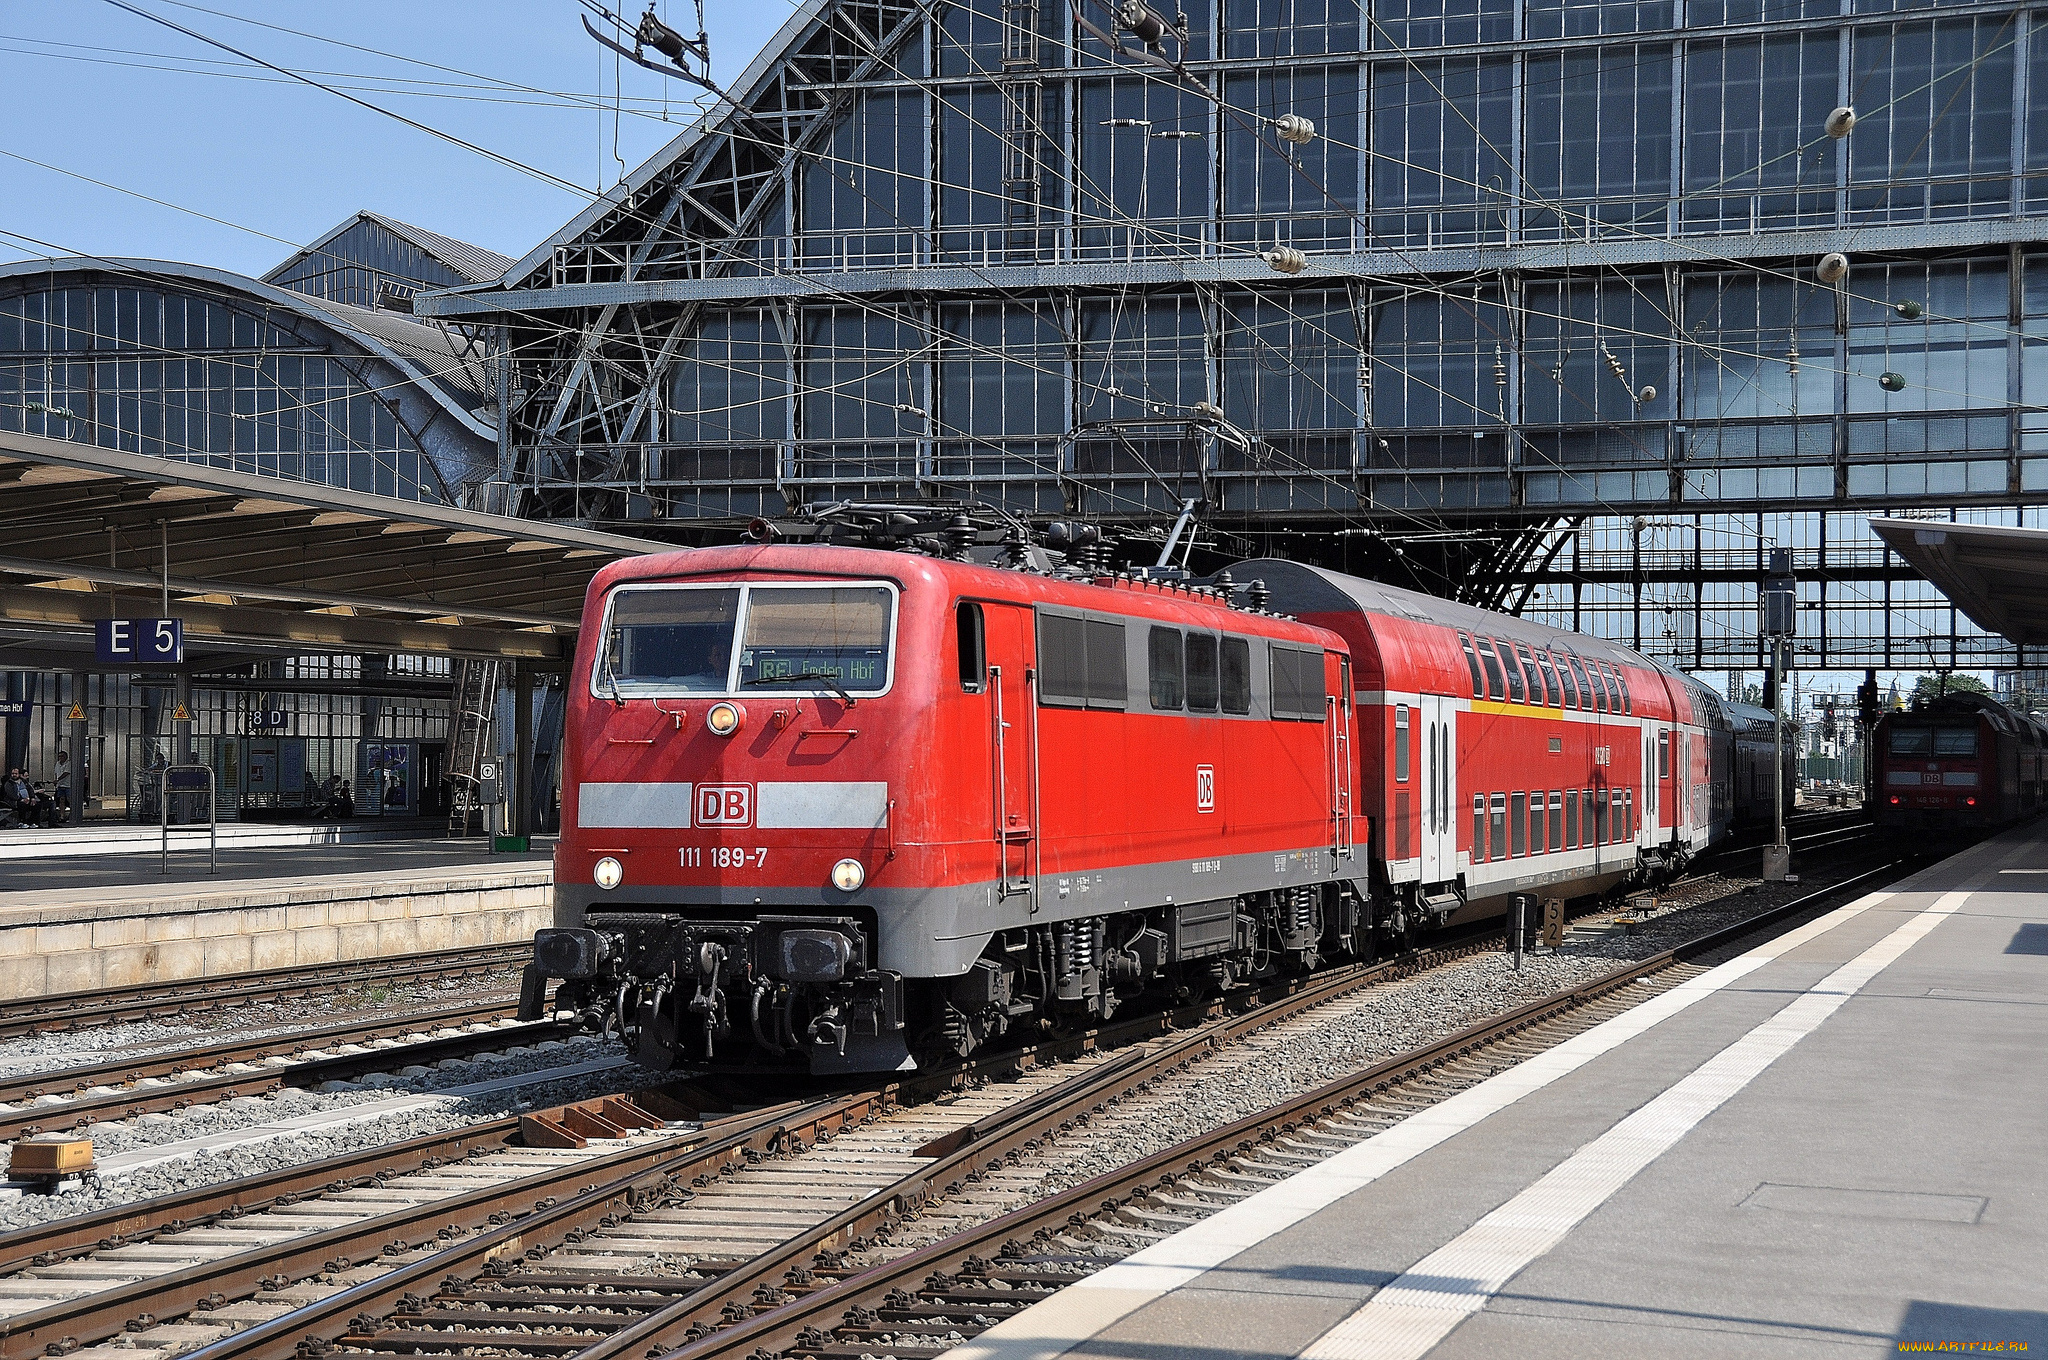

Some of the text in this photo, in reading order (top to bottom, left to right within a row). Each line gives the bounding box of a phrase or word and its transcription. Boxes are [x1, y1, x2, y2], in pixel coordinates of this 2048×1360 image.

[111, 620, 174, 653] E 5
[850, 660, 875, 679] Hbf
[12, 703, 23, 713] Hbf
[253, 711, 281, 725] 8 D
[1925, 774, 1940, 783] DB
[1199, 773, 1212, 804] DB
[702, 790, 746, 820] DB
[678, 847, 769, 868] 111 189-7
[1549, 902, 1559, 920] 5
[1549, 923, 1558, 940] 2
